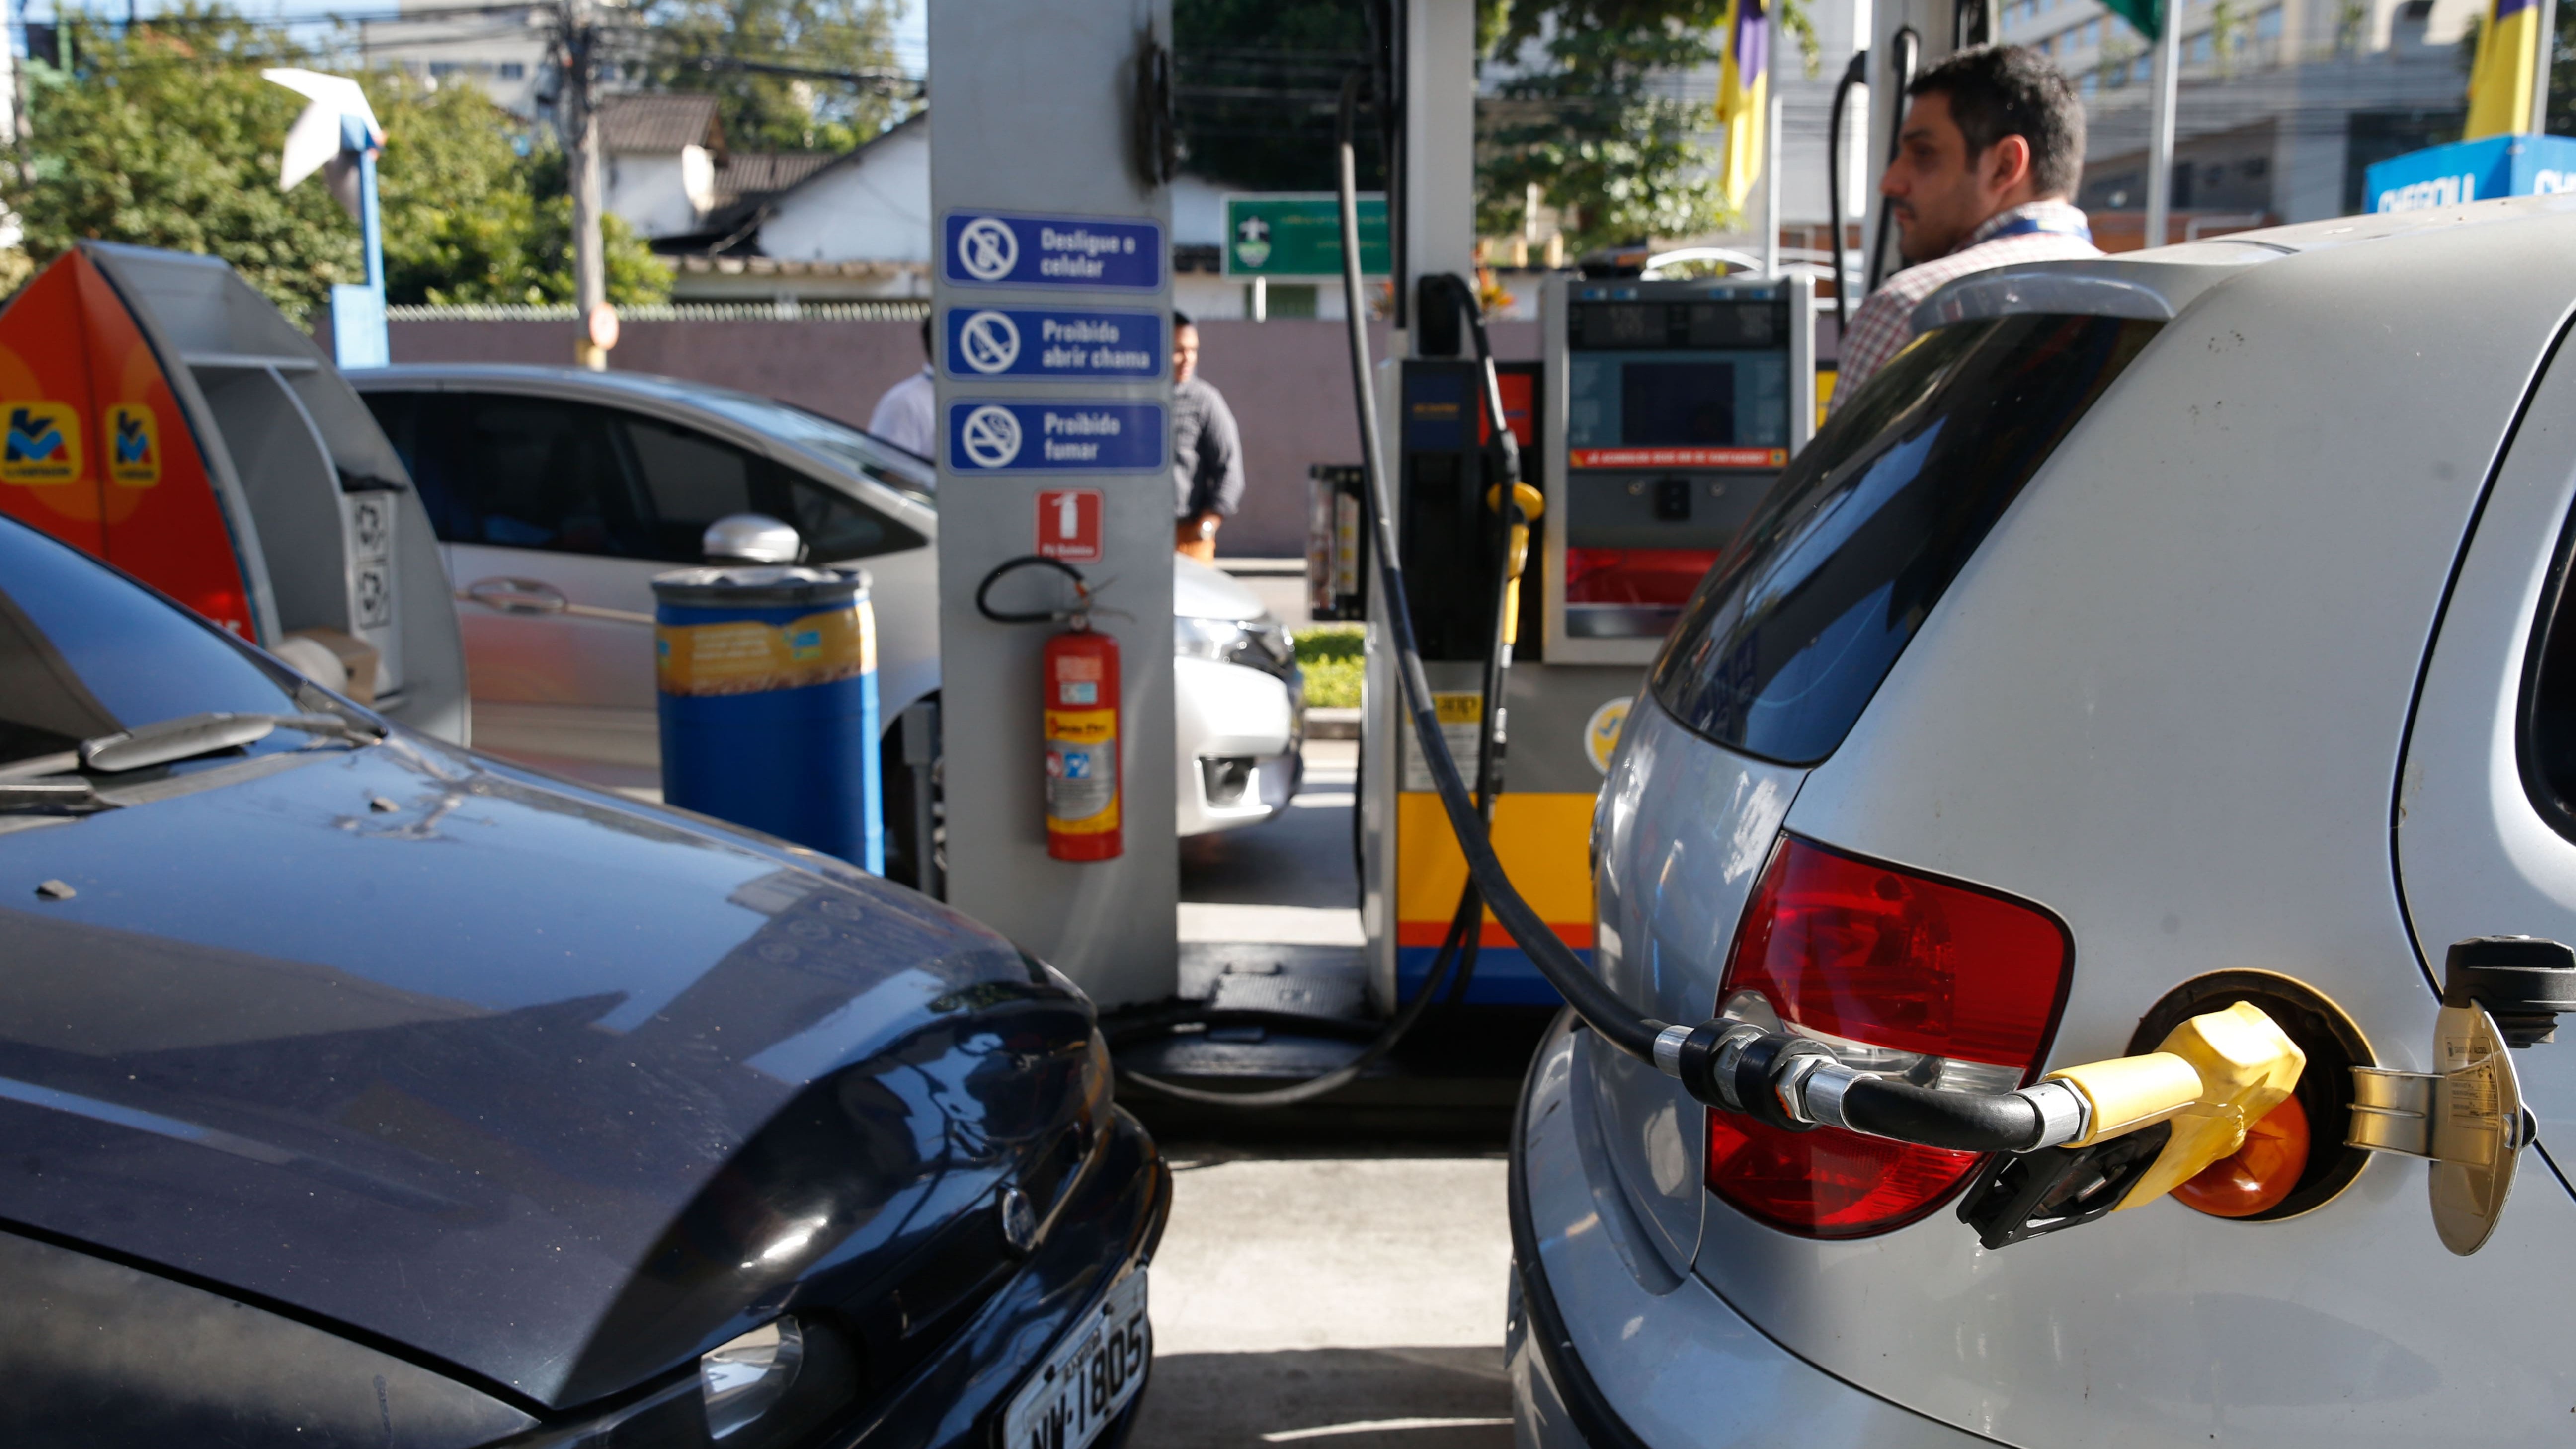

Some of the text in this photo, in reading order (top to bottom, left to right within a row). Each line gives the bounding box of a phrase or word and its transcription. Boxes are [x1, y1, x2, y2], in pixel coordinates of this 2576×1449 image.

[1041, 227, 1136, 257] Desligue o
[1041, 254, 1104, 278] celular
[1042, 319, 1119, 343] Proibido
[1043, 345, 1150, 369] abrir chama
[1044, 413, 1121, 435] Proibido
[1045, 438, 1100, 460] fumar
